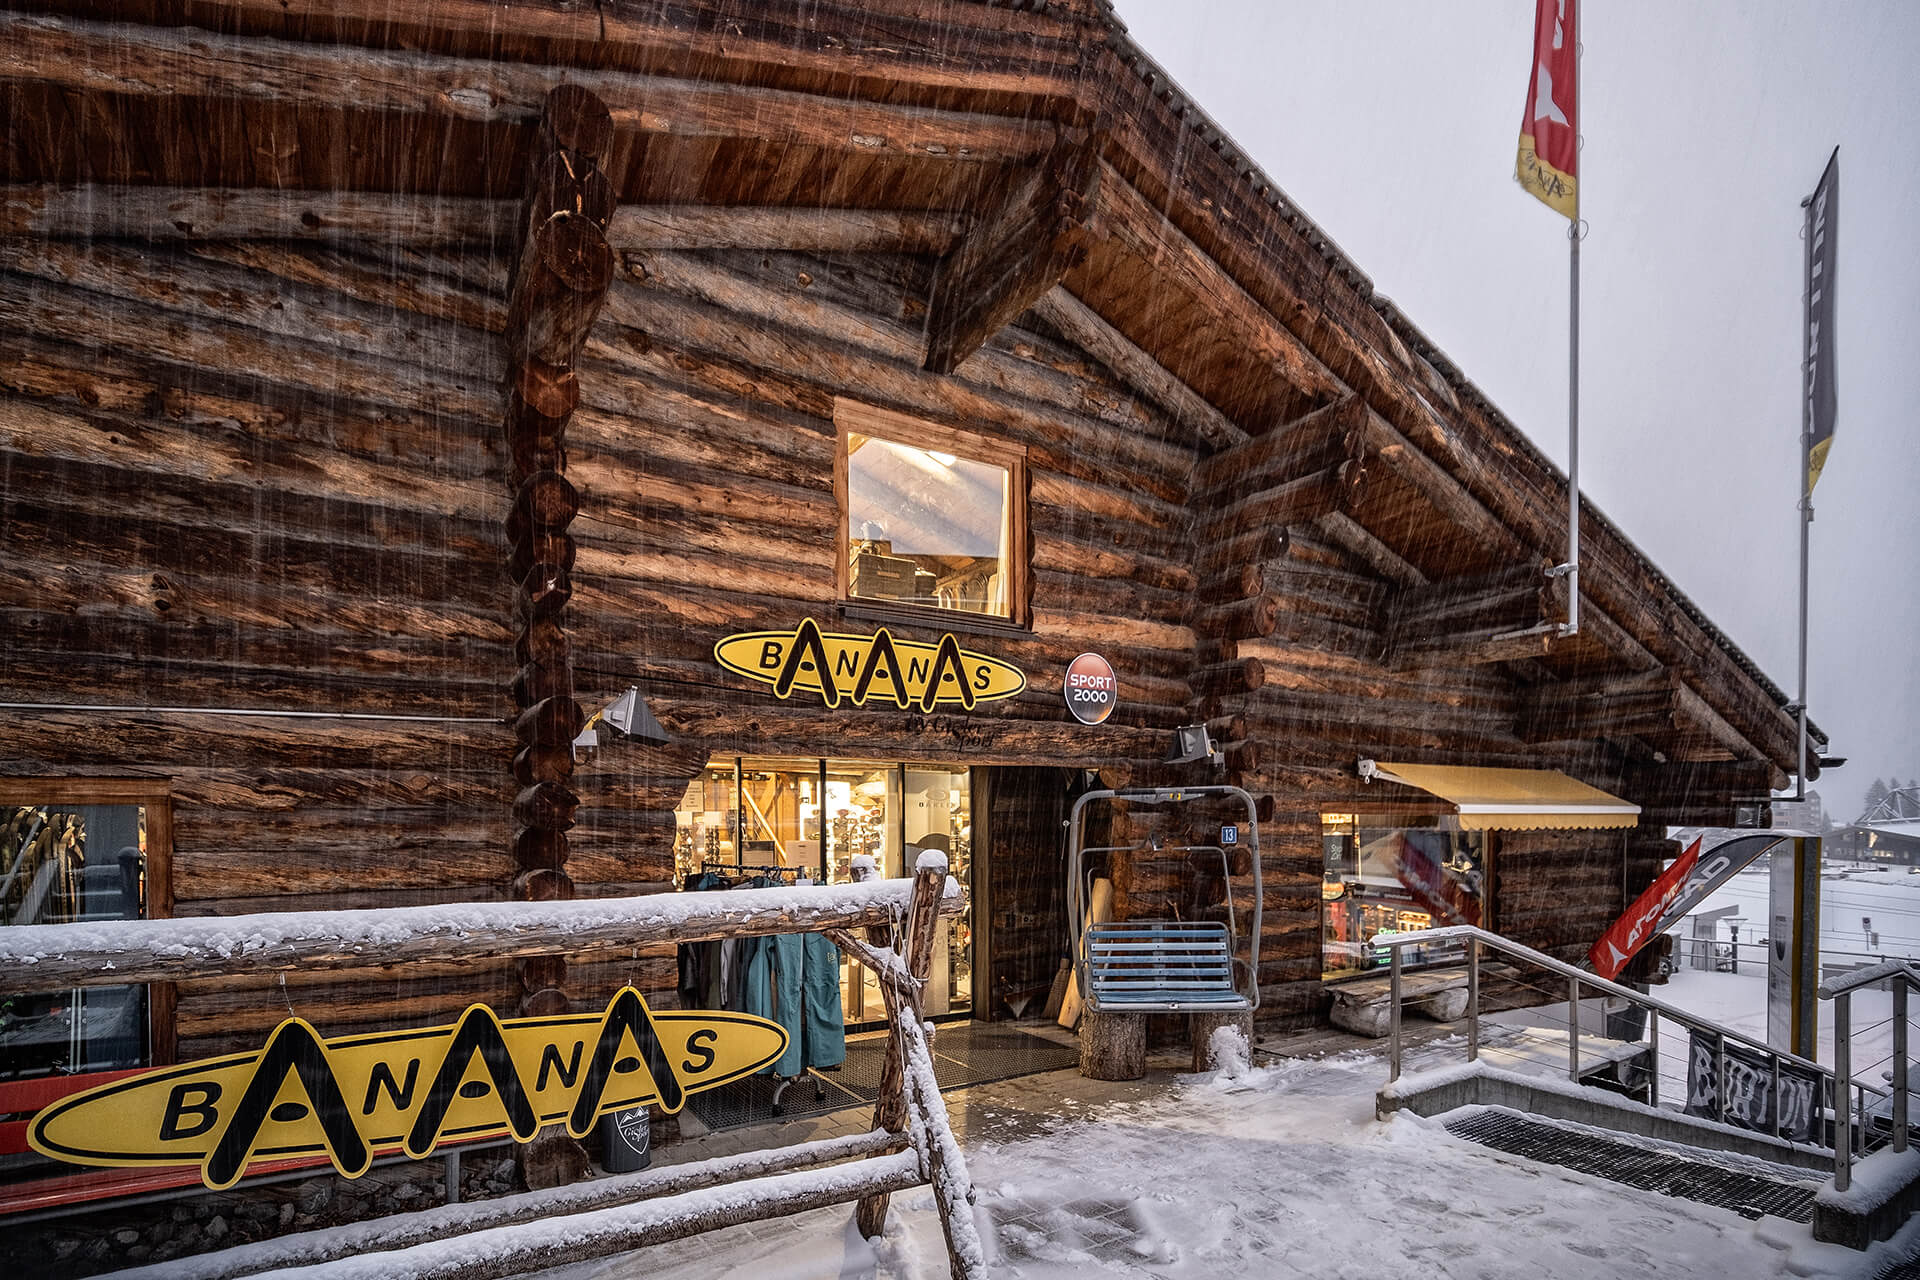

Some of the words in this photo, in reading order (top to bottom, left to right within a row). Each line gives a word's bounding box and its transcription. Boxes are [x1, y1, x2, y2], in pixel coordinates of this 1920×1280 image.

[759, 619, 992, 709] BANANAS
[1070, 673, 1112, 689] SPORT
[1074, 688, 1108, 703] 2000
[1225, 829, 1234, 841] 13
[1626, 862, 1695, 950] ATOM
[1658, 856, 1730, 922] EAD
[158, 991, 718, 1185] BANANAS
